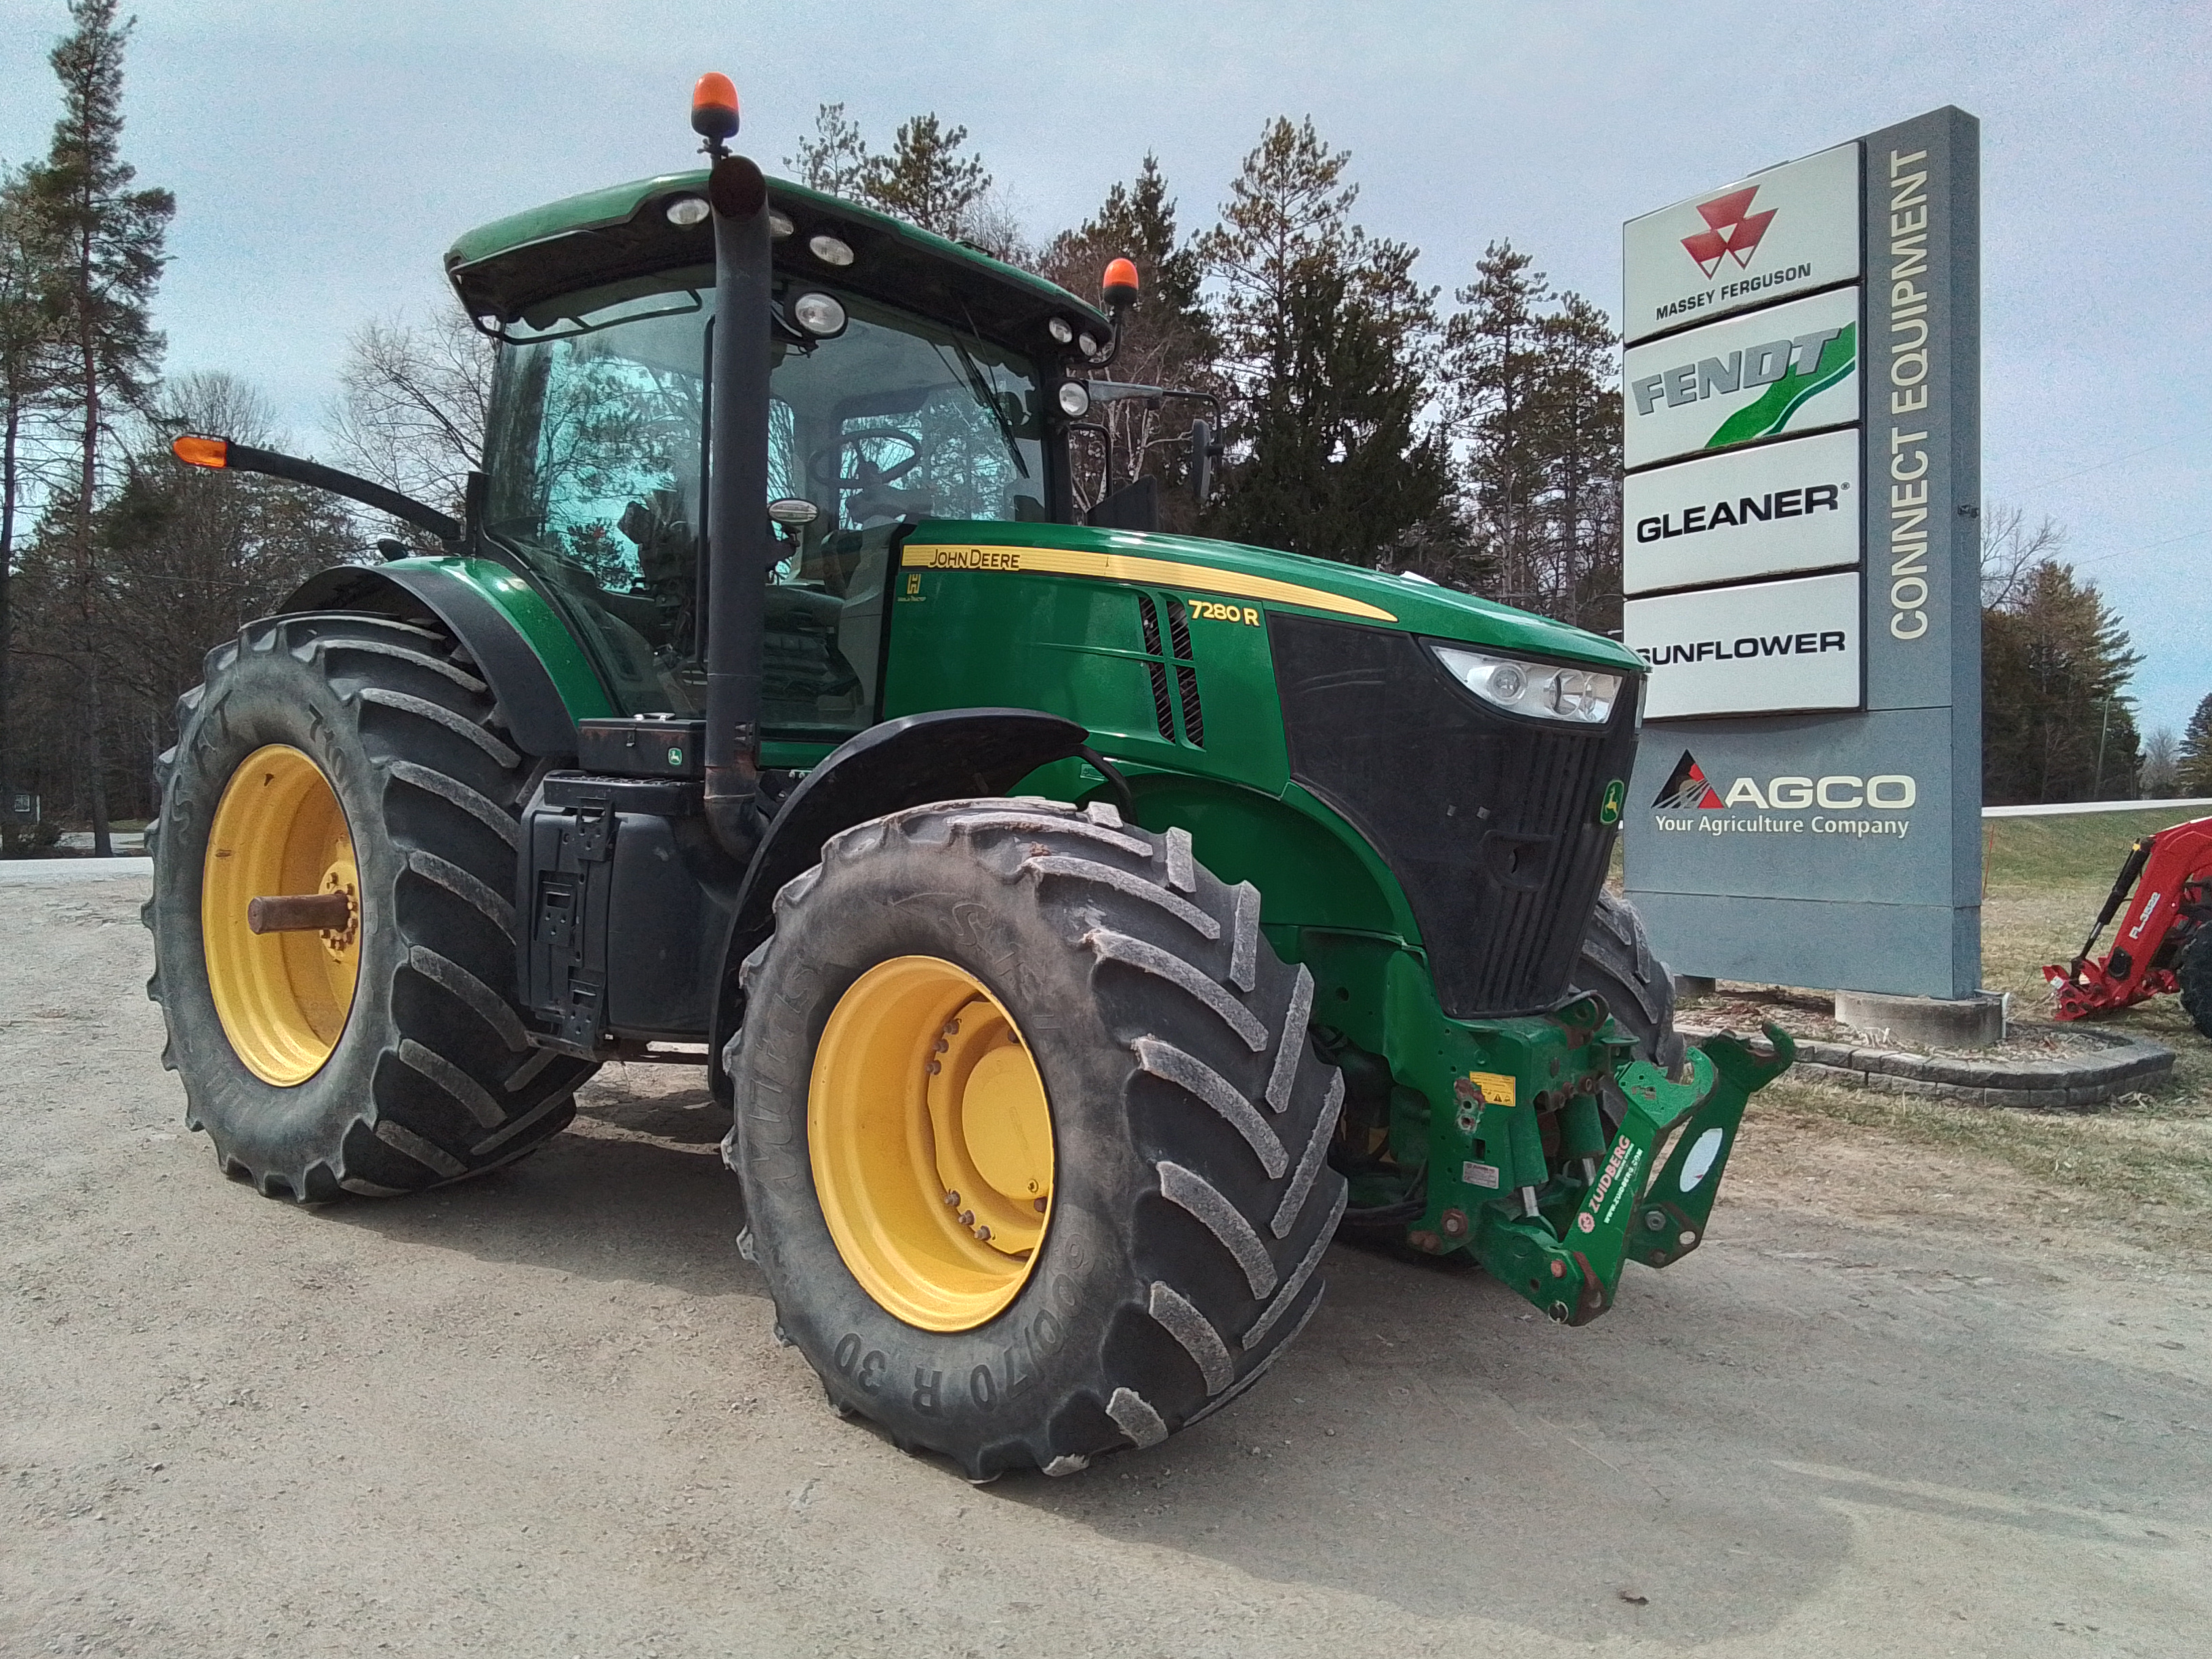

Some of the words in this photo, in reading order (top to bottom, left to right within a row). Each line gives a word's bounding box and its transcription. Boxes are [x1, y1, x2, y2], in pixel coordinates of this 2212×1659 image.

[1656, 290, 1715, 321] MASSEY
[1721, 263, 1811, 301] FERGUSON
[1891, 150, 1928, 415] EQUIPMENT
[1632, 327, 1842, 416] FENDT
[1890, 428, 1929, 640] CONNECT
[1188, 600, 1240, 621] 7280
[1242, 607, 1261, 626] R
[1724, 775, 1917, 810] AGCO
[1656, 816, 1694, 832] Your
[1698, 815, 1804, 836] Agriculture
[1811, 816, 1910, 838] Company
[1589, 1134, 1631, 1214] ZUIDBERG
[970, 1232, 1092, 1414] 600/70
[834, 1332, 886, 1393] 30
[912, 1368, 943, 1416] R
